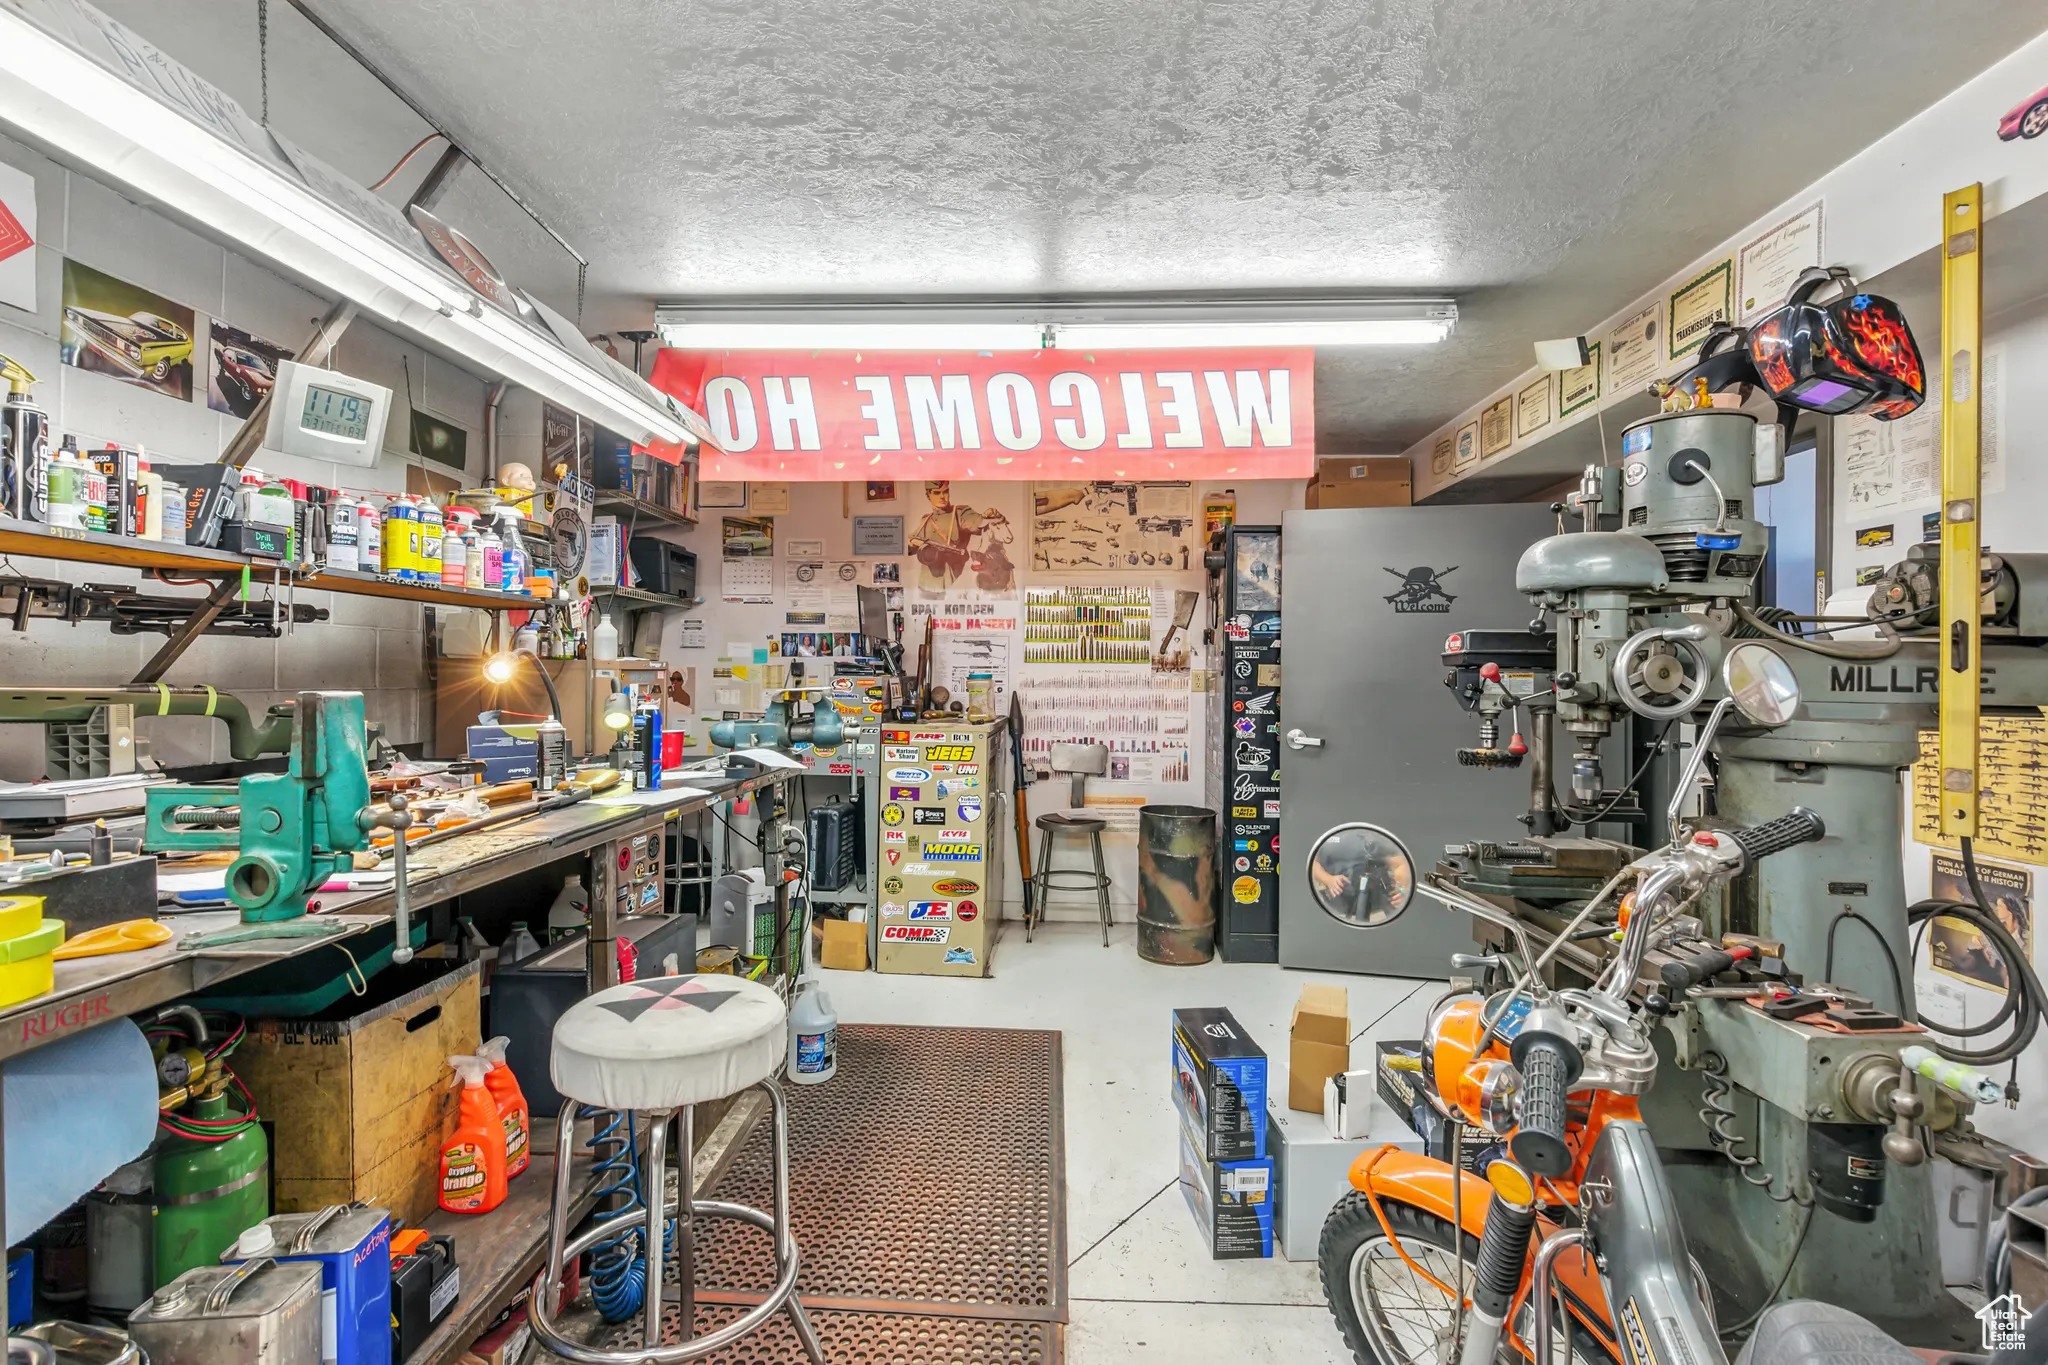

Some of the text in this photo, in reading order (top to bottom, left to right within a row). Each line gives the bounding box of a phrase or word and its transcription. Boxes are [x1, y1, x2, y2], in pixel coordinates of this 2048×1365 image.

[1676, 313, 1714, 343] TRANSMISSIONS
[255, 532, 270, 541] Drill
[260, 542, 275, 551] Bits
[1394, 600, 1450, 613] Welcome
[1830, 665, 1997, 695] MILLRE
[927, 746, 974, 761] JEGS
[957, 765, 979, 775] UNI
[886, 831, 904, 839] RK
[924, 844, 981, 855] MOOG
[1937, 859, 1953, 867] OWN
[1992, 870, 2025, 881] GERMAN
[1936, 866, 1963, 876] WORLD
[1991, 876, 2024, 889] HISTORY
[885, 927, 934, 938] COMP
[22, 995, 112, 1041] RUGER
[448, 1164, 476, 1176] Oxygen
[443, 1172, 483, 1191] Orange
[353, 1223, 390, 1268] Acetone
